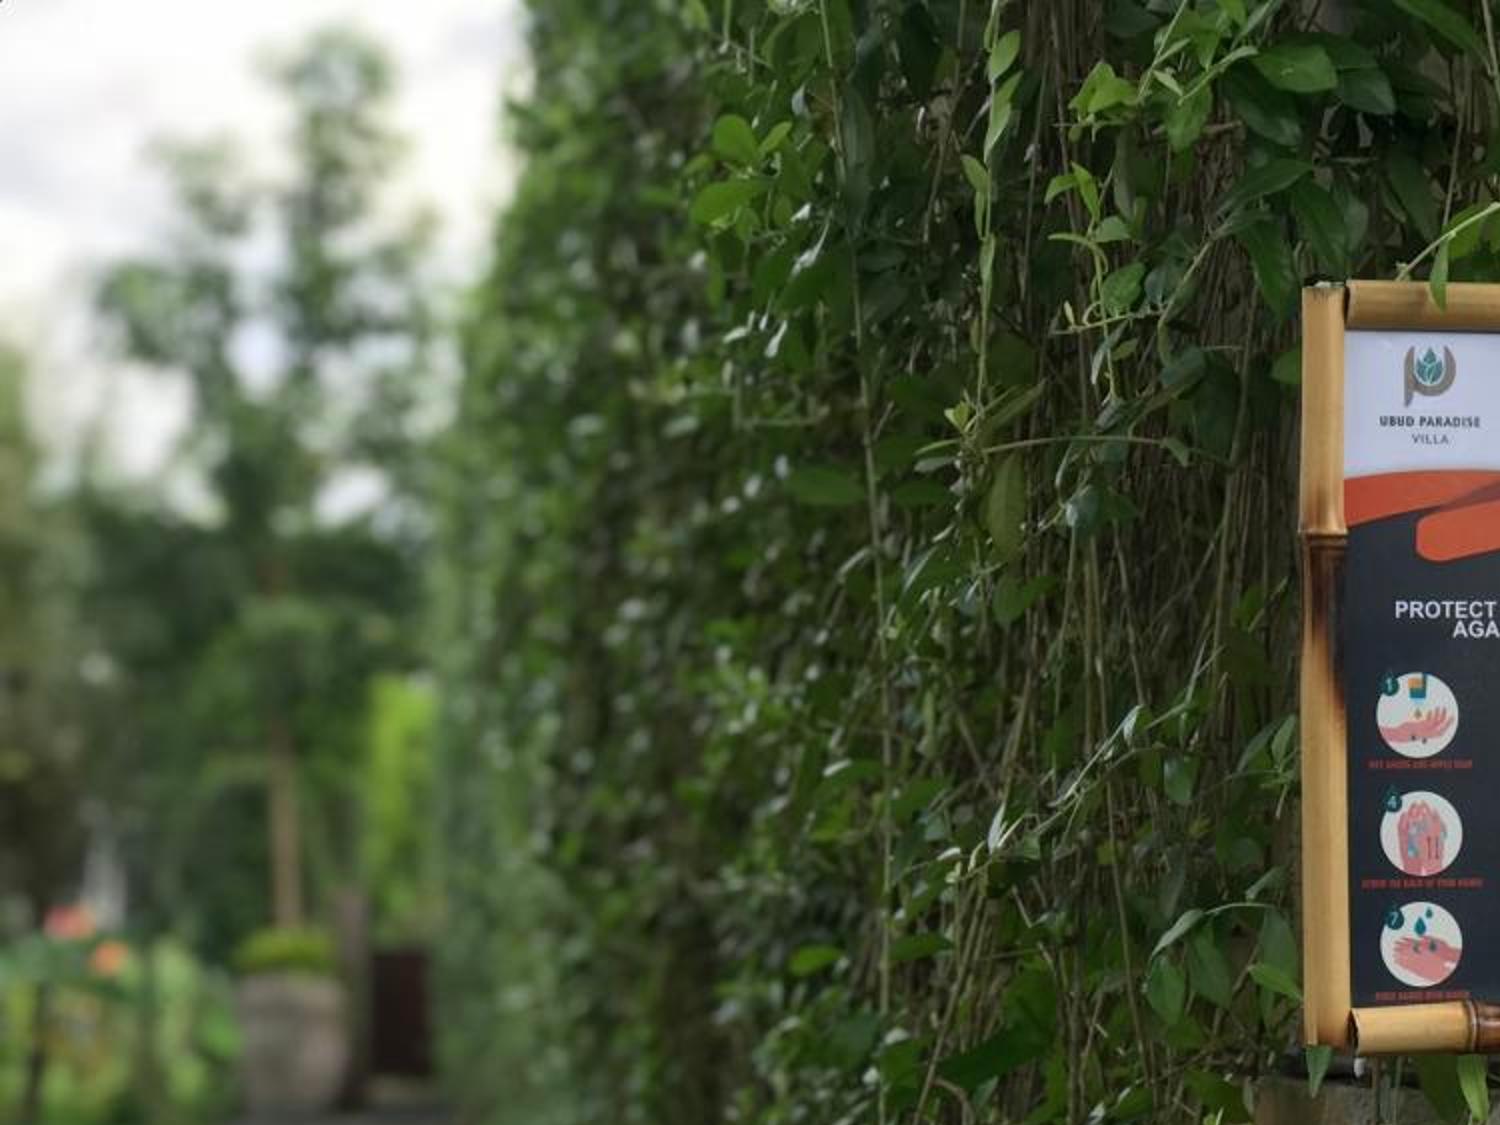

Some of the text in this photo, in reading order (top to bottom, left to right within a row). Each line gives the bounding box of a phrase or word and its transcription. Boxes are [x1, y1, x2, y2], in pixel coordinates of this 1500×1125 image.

[1380, 416, 1480, 428] UBUD PARADISE
[1412, 434, 1449, 445] VILLA
[1395, 601, 1497, 619] PROTECT
[1387, 796, 1398, 809] 4
[1389, 912, 1399, 926] 7
